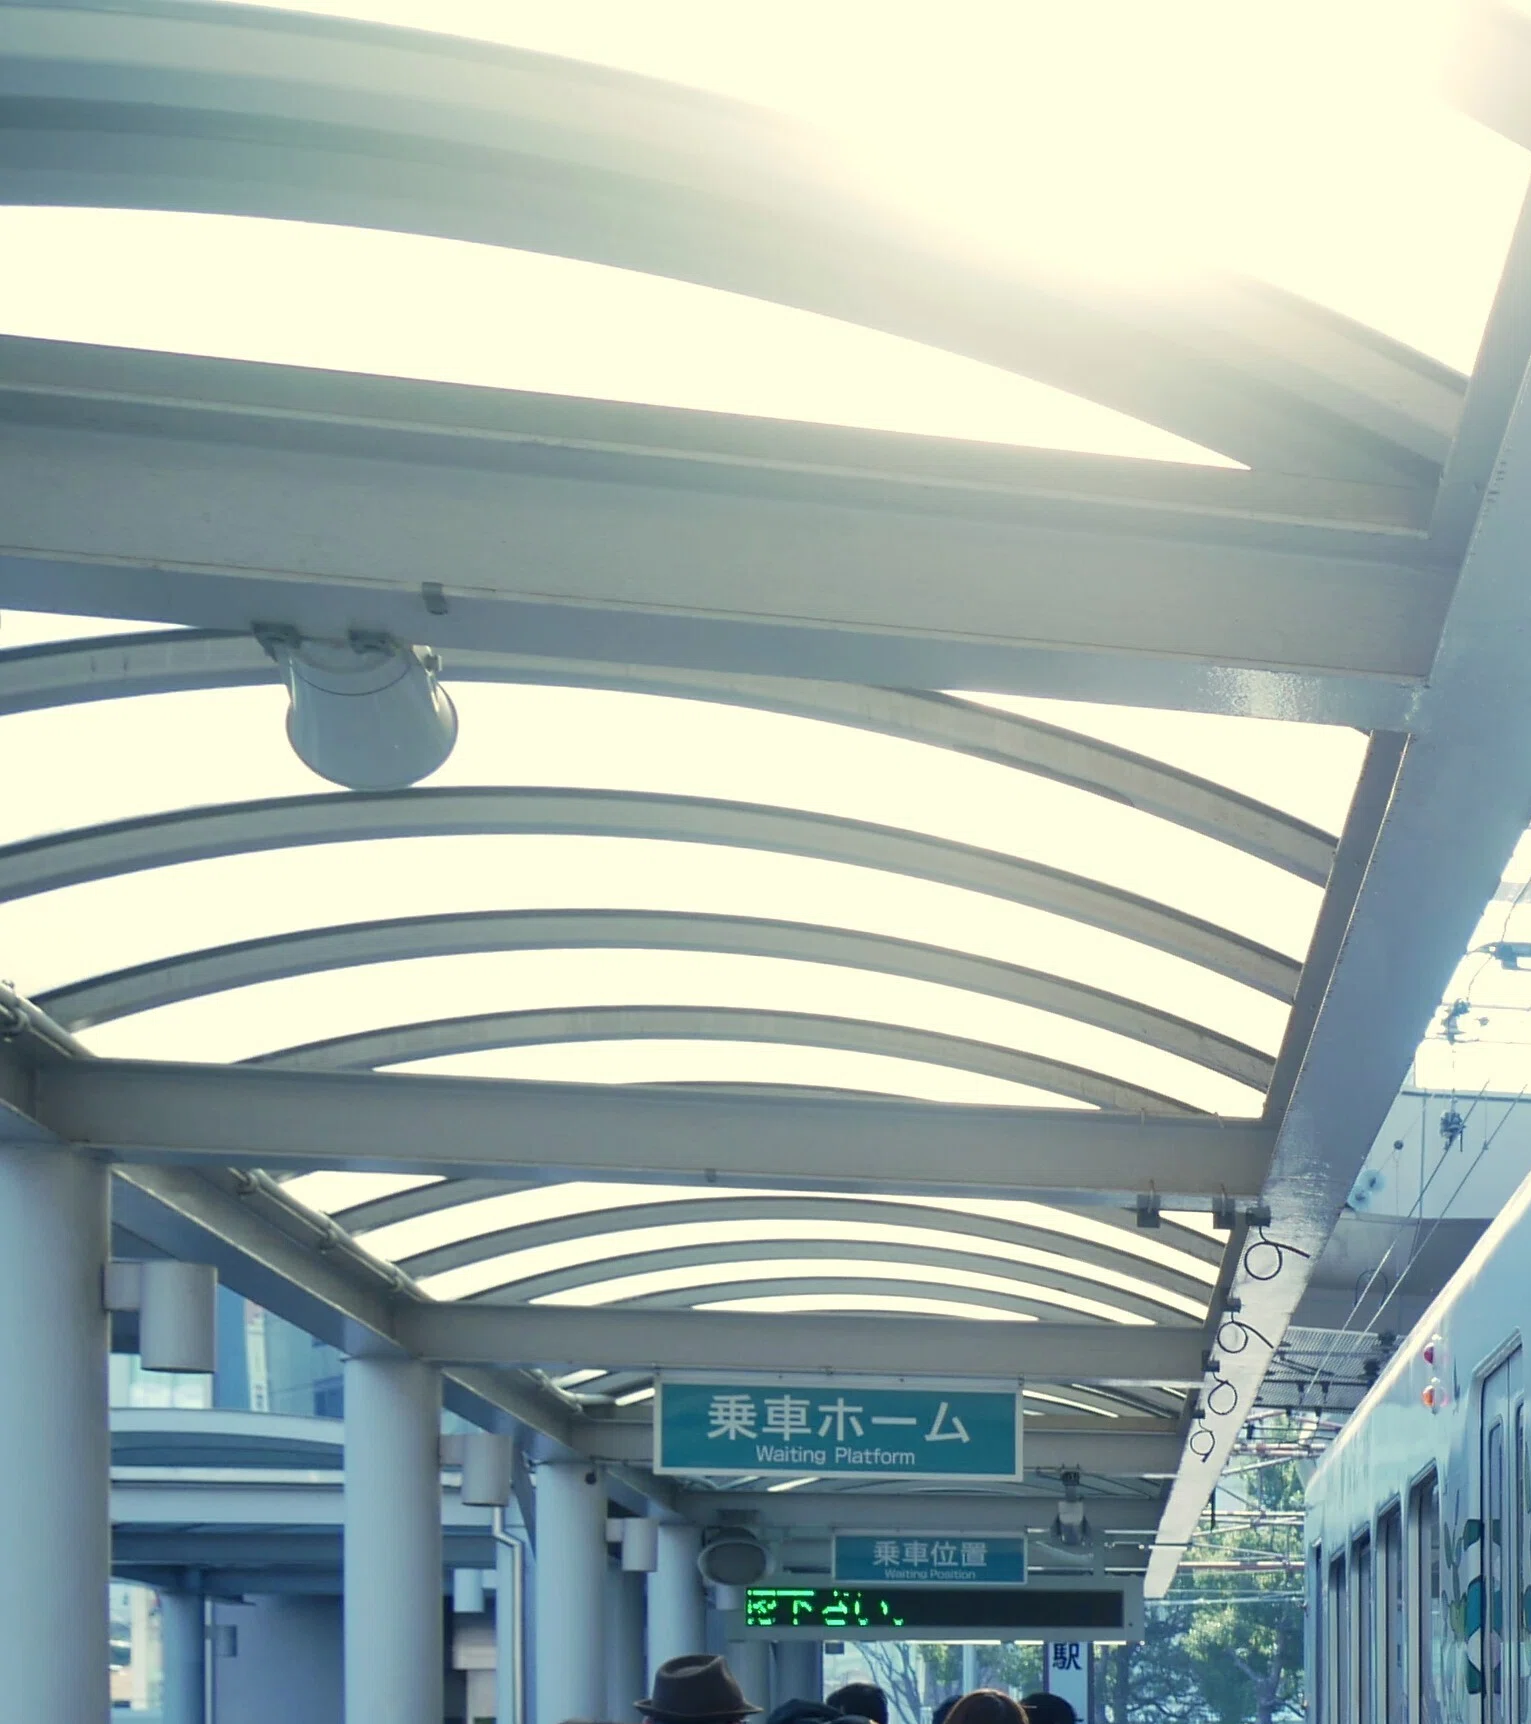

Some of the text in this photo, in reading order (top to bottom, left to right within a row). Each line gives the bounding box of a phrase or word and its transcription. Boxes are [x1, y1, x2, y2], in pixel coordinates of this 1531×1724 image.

[707, 1394, 971, 1444] 乗車ホーム
[756, 1445, 916, 1466] Waiting Platform
[872, 1540, 988, 1567] 乗車位置
[885, 1568, 976, 1580] Waiting Position
